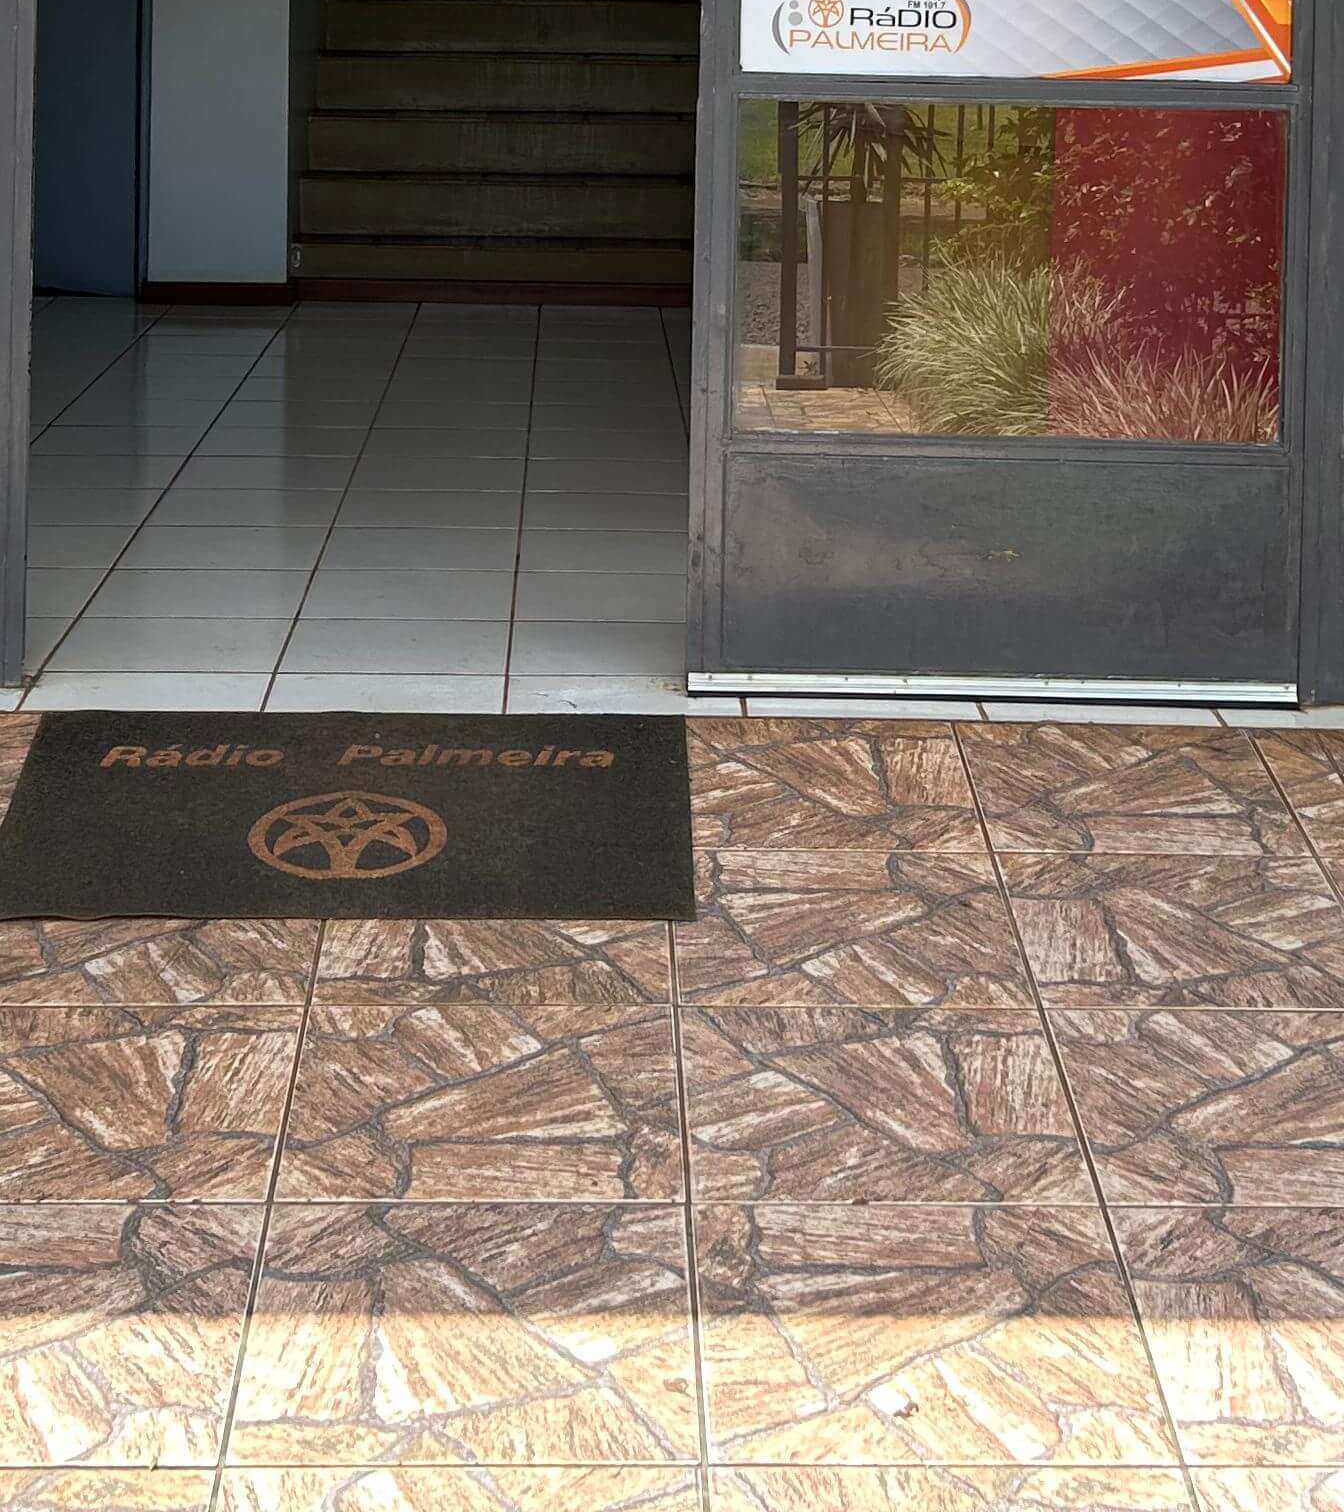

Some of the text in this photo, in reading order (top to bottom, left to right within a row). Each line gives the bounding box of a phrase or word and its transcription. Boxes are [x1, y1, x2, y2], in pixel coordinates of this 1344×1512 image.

[907, 1, 921, 9] FM
[789, 29, 952, 53] PALMEIRA
[100, 744, 617, 769] Rádio Palmeira
